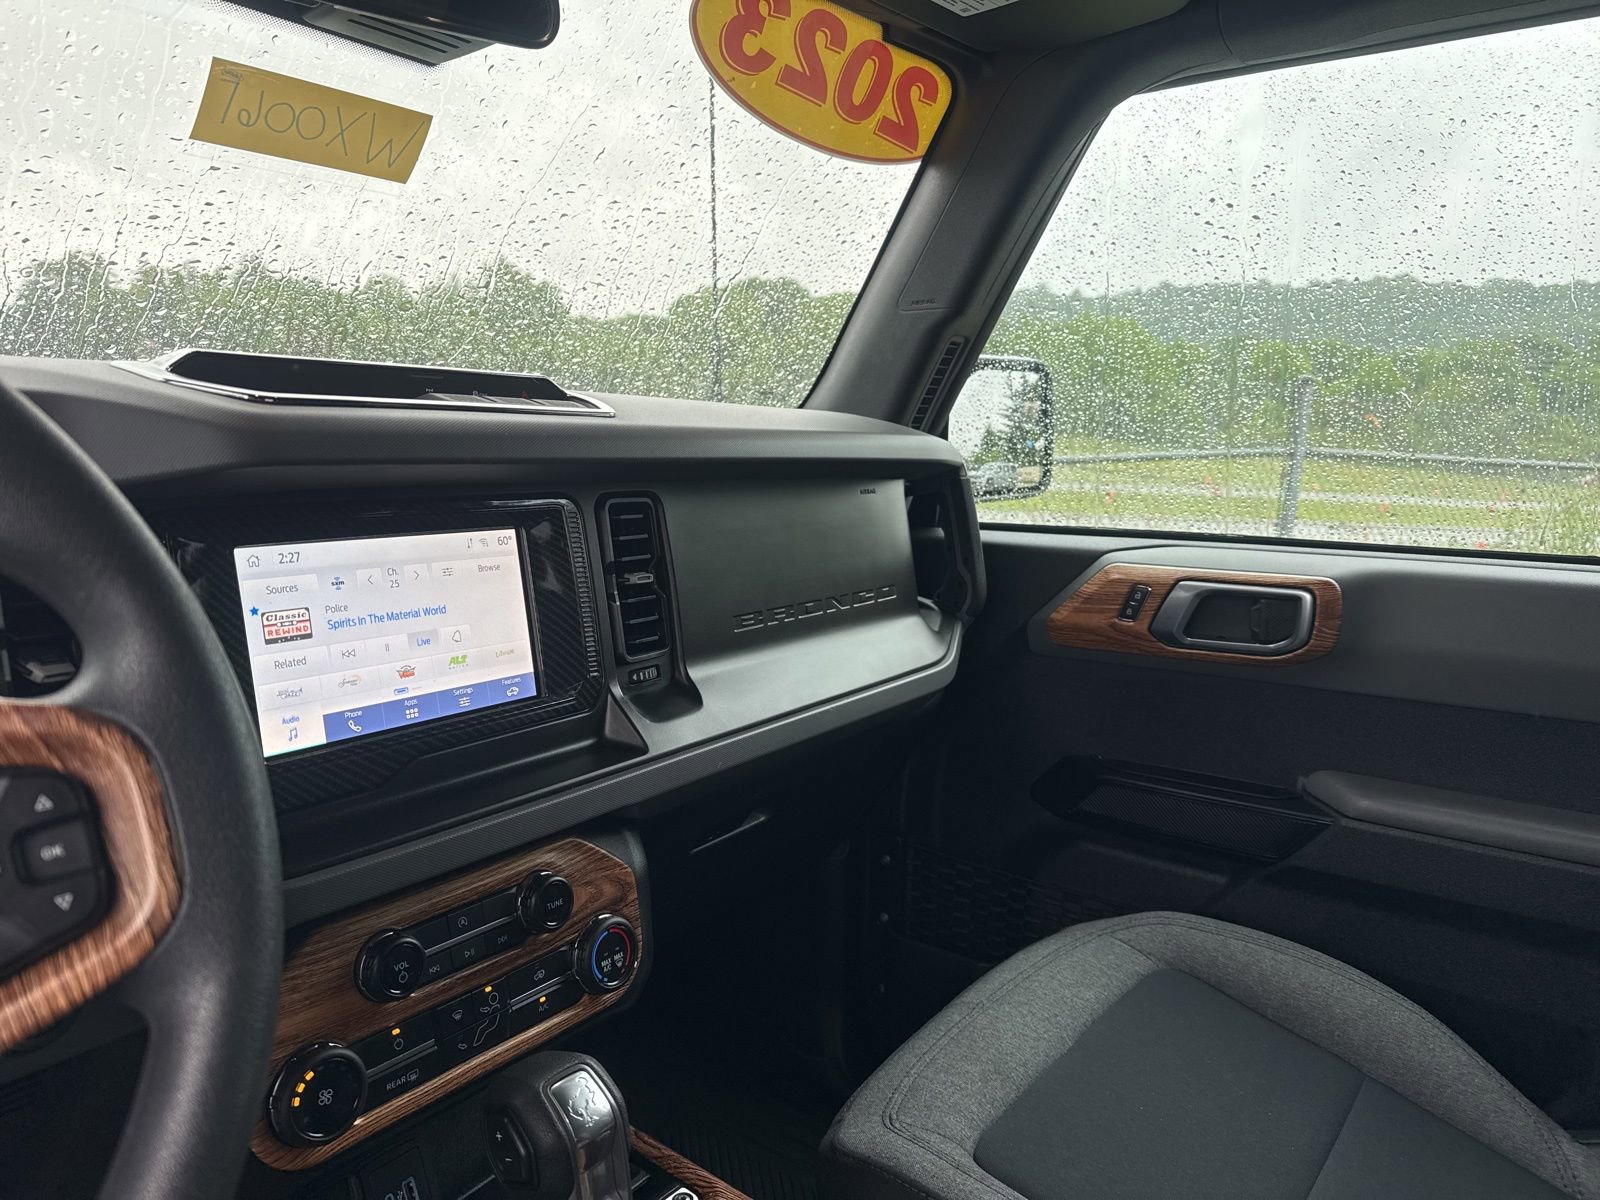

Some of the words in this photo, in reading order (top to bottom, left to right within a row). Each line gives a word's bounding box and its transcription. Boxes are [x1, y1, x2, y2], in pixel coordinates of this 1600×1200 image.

[278, 551, 300, 564] 2:27
[478, 564, 501, 573] Browse
[266, 584, 299, 595] Sources
[389, 580, 400, 589] 25
[325, 603, 349, 614] Police
[733, 583, 897, 633] BRONCO
[265, 611, 306, 622] Classic
[327, 618, 357, 631] Spirits
[358, 616, 366, 626] In
[368, 613, 385, 623] The
[387, 608, 421, 621] Material
[422, 604, 447, 617] World
[267, 625, 309, 637] REWIND
[417, 637, 431, 647] Live
[274, 656, 307, 670] Related
[502, 677, 522, 686] Features
[453, 687, 474, 696] Settings
[404, 699, 418, 707] Apps
[344, 709, 362, 719] Phone
[282, 715, 300, 725] Audio
[40, 842, 65, 861] OK
[546, 897, 564, 911] TUNE
[394, 959, 410, 972] VOL
[386, 1074, 407, 1091] REAR
